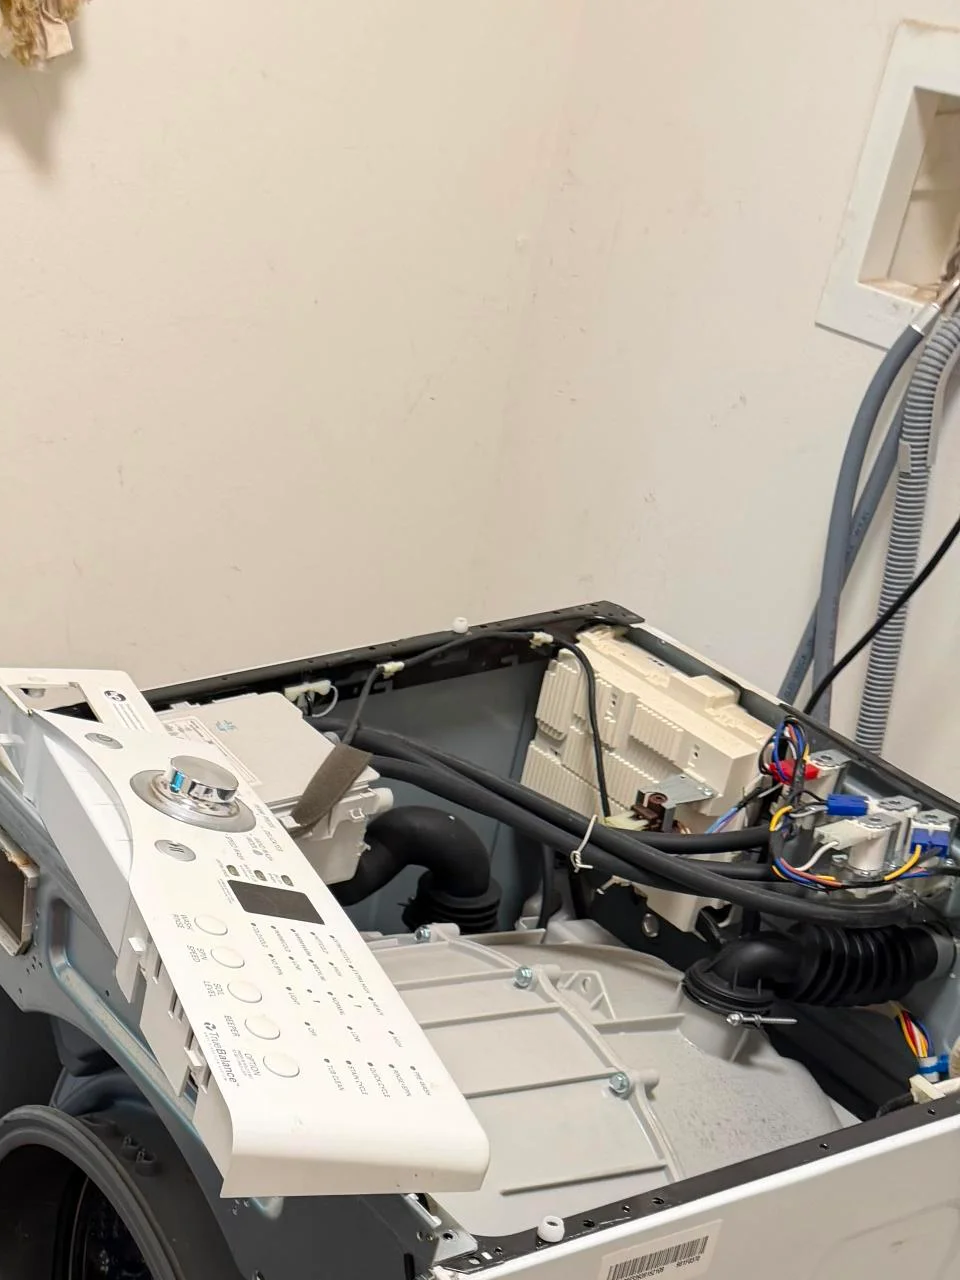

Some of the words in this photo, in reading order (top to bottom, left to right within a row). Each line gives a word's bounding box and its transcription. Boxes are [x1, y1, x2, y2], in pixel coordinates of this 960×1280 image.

[187, 945, 201, 963] SPEED
[203, 980, 216, 998] LEVEL
[224, 1014, 241, 1037] BEEPER
[244, 1052, 262, 1077] OPTION
